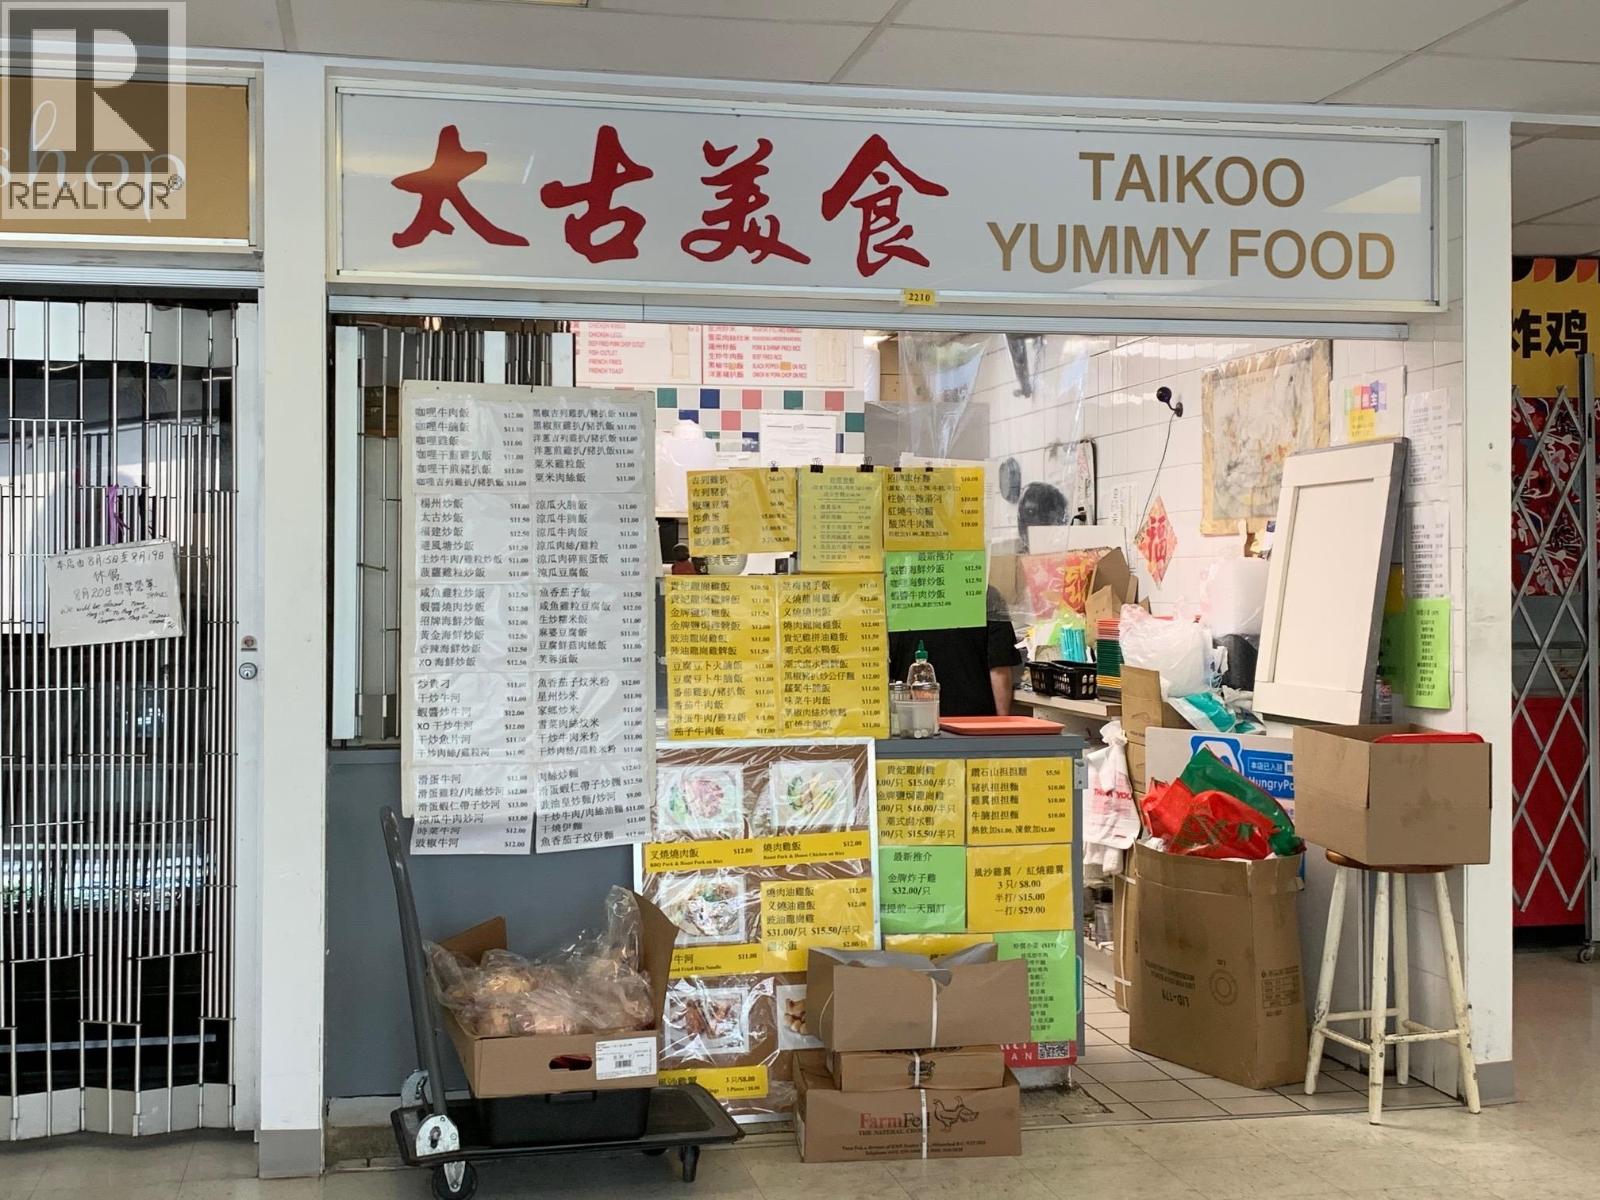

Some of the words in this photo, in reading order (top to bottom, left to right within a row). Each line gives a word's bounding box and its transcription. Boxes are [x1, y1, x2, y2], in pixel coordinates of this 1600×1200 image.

[1078, 151, 1305, 208] TAIKOO
[391, 125, 949, 277] 太古美食
[986, 221, 1210, 276] YUMMY
[1229, 228, 1396, 280] FOOD
[909, 292, 930, 302] 2210
[908, 829, 956, 838] $15.50/半只
[893, 851, 932, 862] 最新推介
[1026, 865, 1064, 876] 紅燒雞翼
[888, 873, 936, 883] 金牌炸子雞
[998, 881, 1003, 889] 3
[1018, 880, 1041, 888] $8.00
[892, 887, 931, 896] $32.00/只
[1018, 893, 1045, 902] $15.00
[995, 906, 1016, 915] 一打/
[1018, 906, 1046, 914] $29.00
[767, 927, 807, 937] $31.00/只
[811, 925, 860, 935] $15.50/半只
